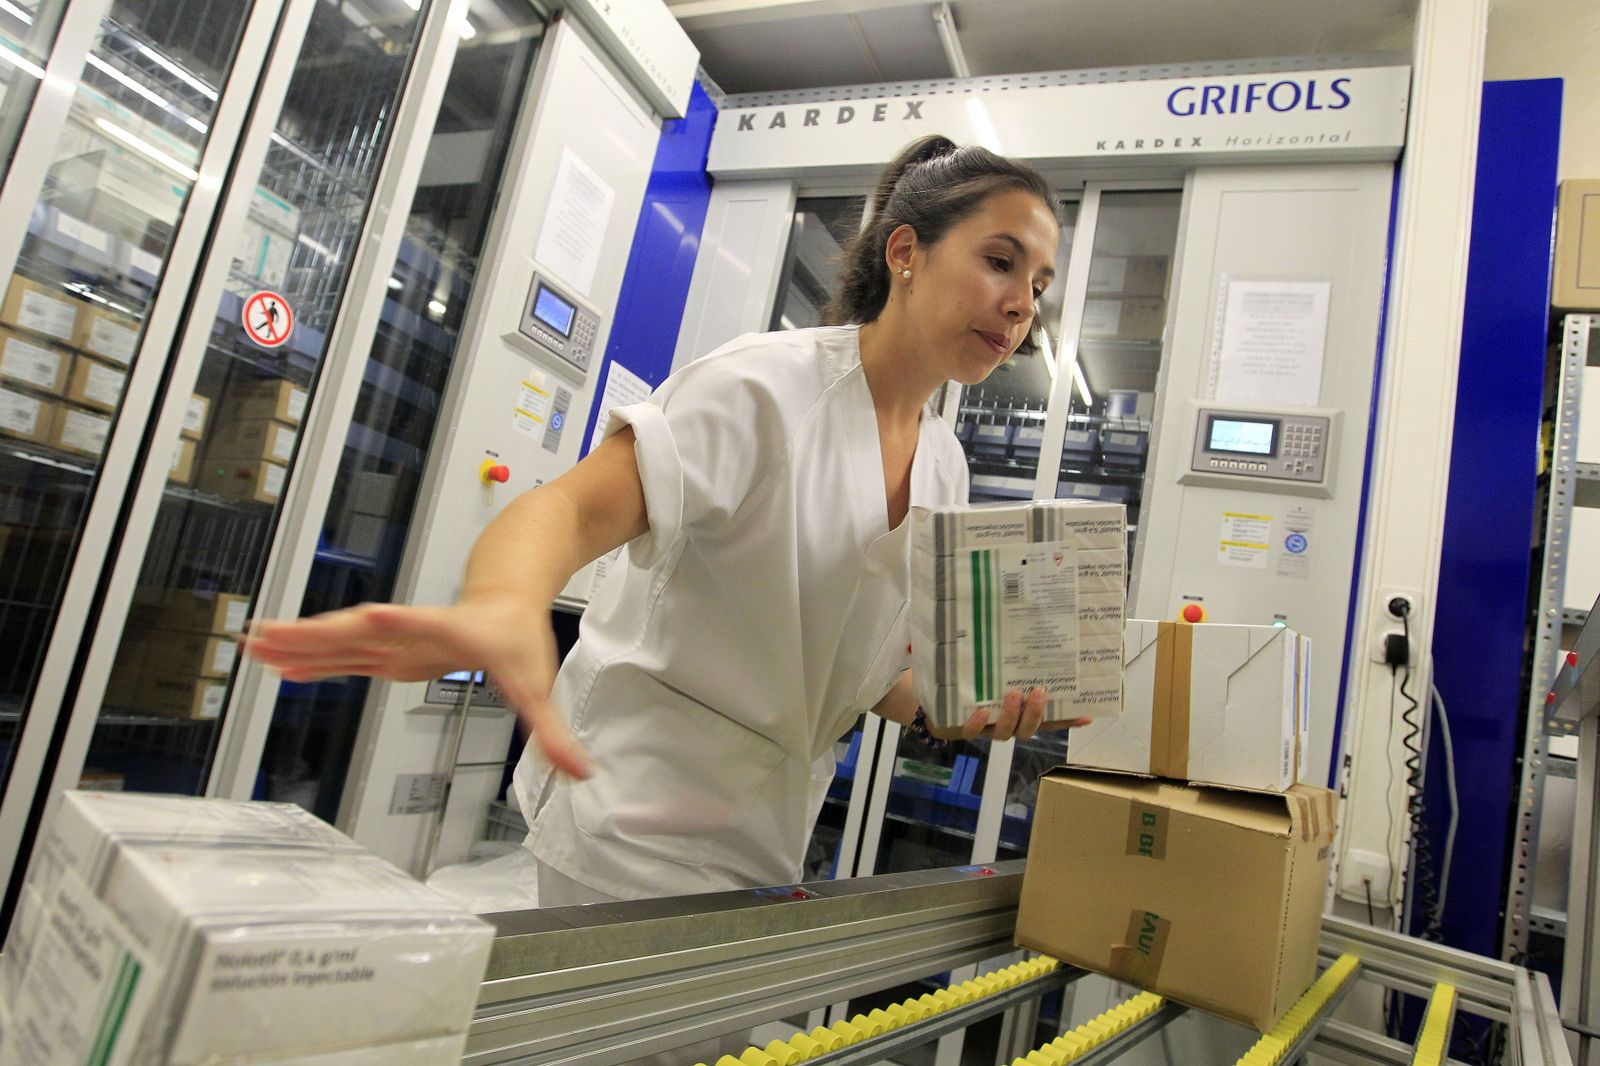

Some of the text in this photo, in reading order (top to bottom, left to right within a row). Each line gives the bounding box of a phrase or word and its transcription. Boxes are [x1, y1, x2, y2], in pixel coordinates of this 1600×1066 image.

[1167, 78, 1352, 116] GRIFOLS
[737, 101, 924, 132] KARDEX
[1096, 130, 1351, 150] KARDEX Horizontal
